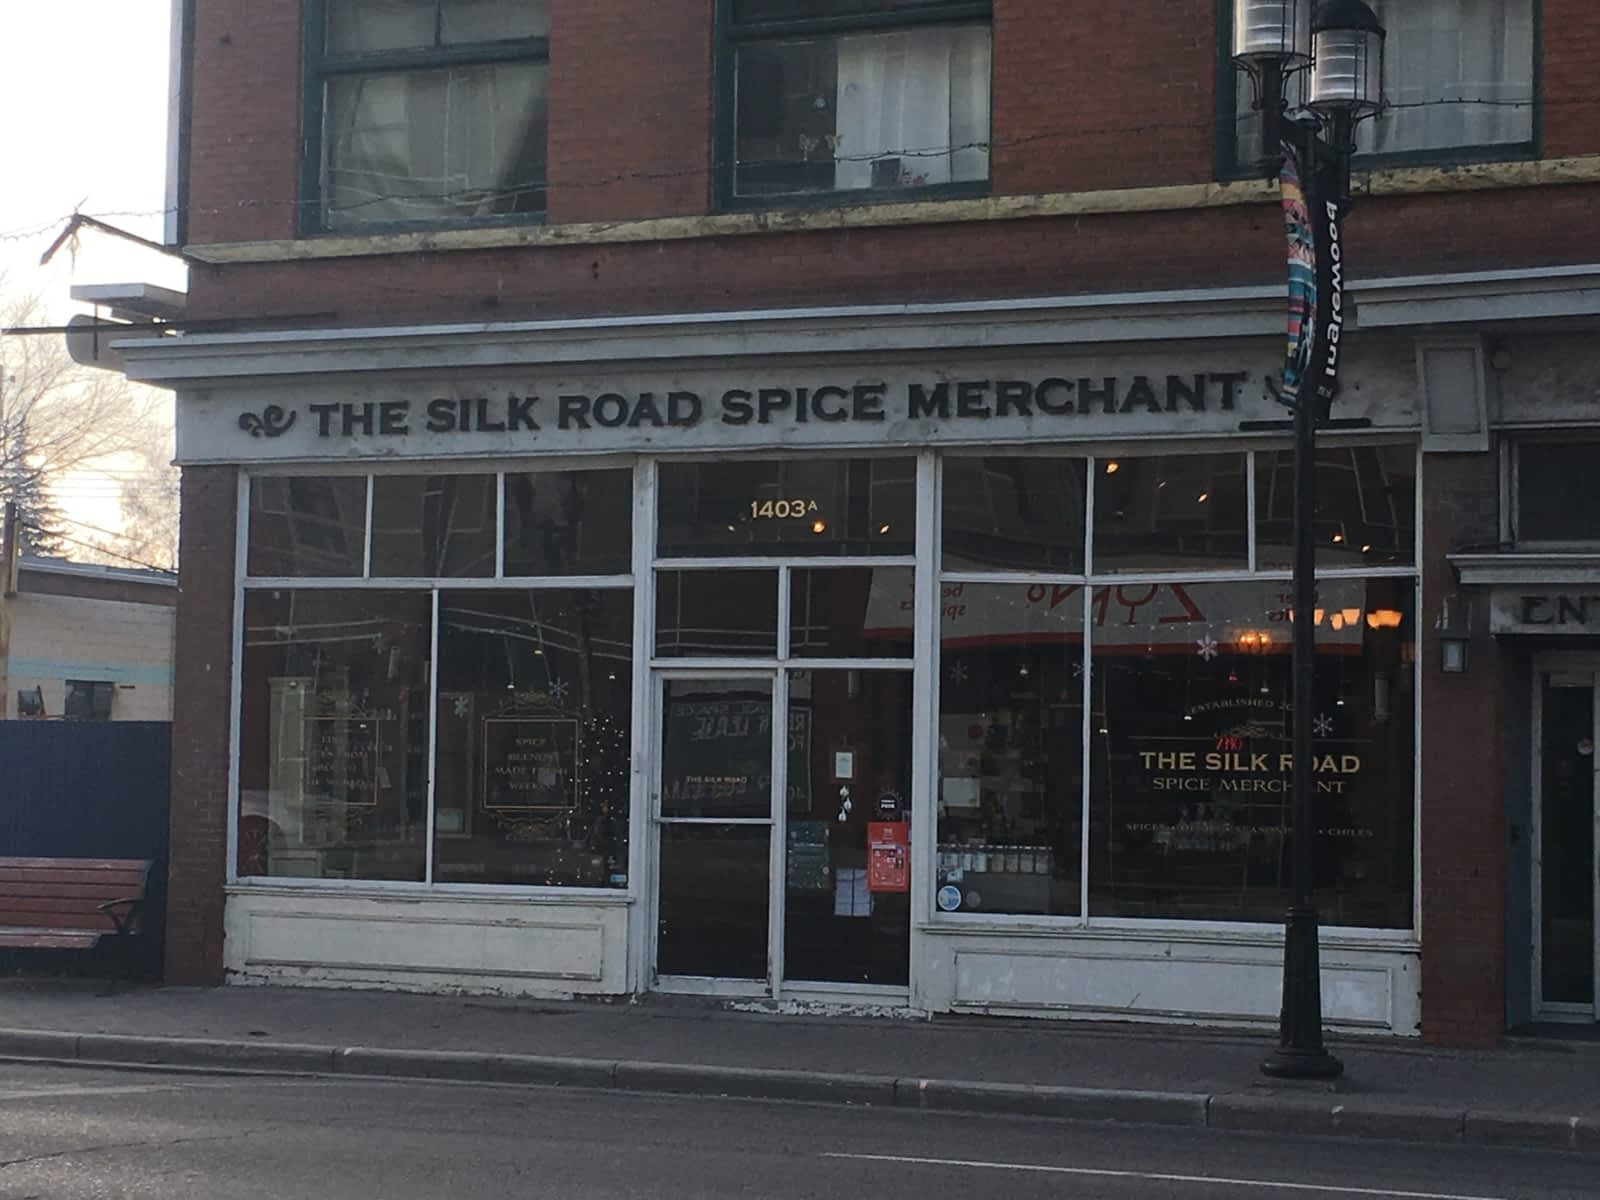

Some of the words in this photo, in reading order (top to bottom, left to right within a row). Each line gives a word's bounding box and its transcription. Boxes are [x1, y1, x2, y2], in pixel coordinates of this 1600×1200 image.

[309, 402, 409, 437] THE
[426, 396, 541, 433] SILK
[558, 390, 702, 430] ROAD
[720, 383, 886, 426] SPICE
[907, 372, 1248, 420] MERCHANT
[1139, 752, 1196, 770] THE
[1205, 753, 1267, 772] SILK
[1278, 755, 1361, 774] RAD
[1152, 777, 1210, 791] SPICE
[1218, 778, 1347, 793] MERCHNT
